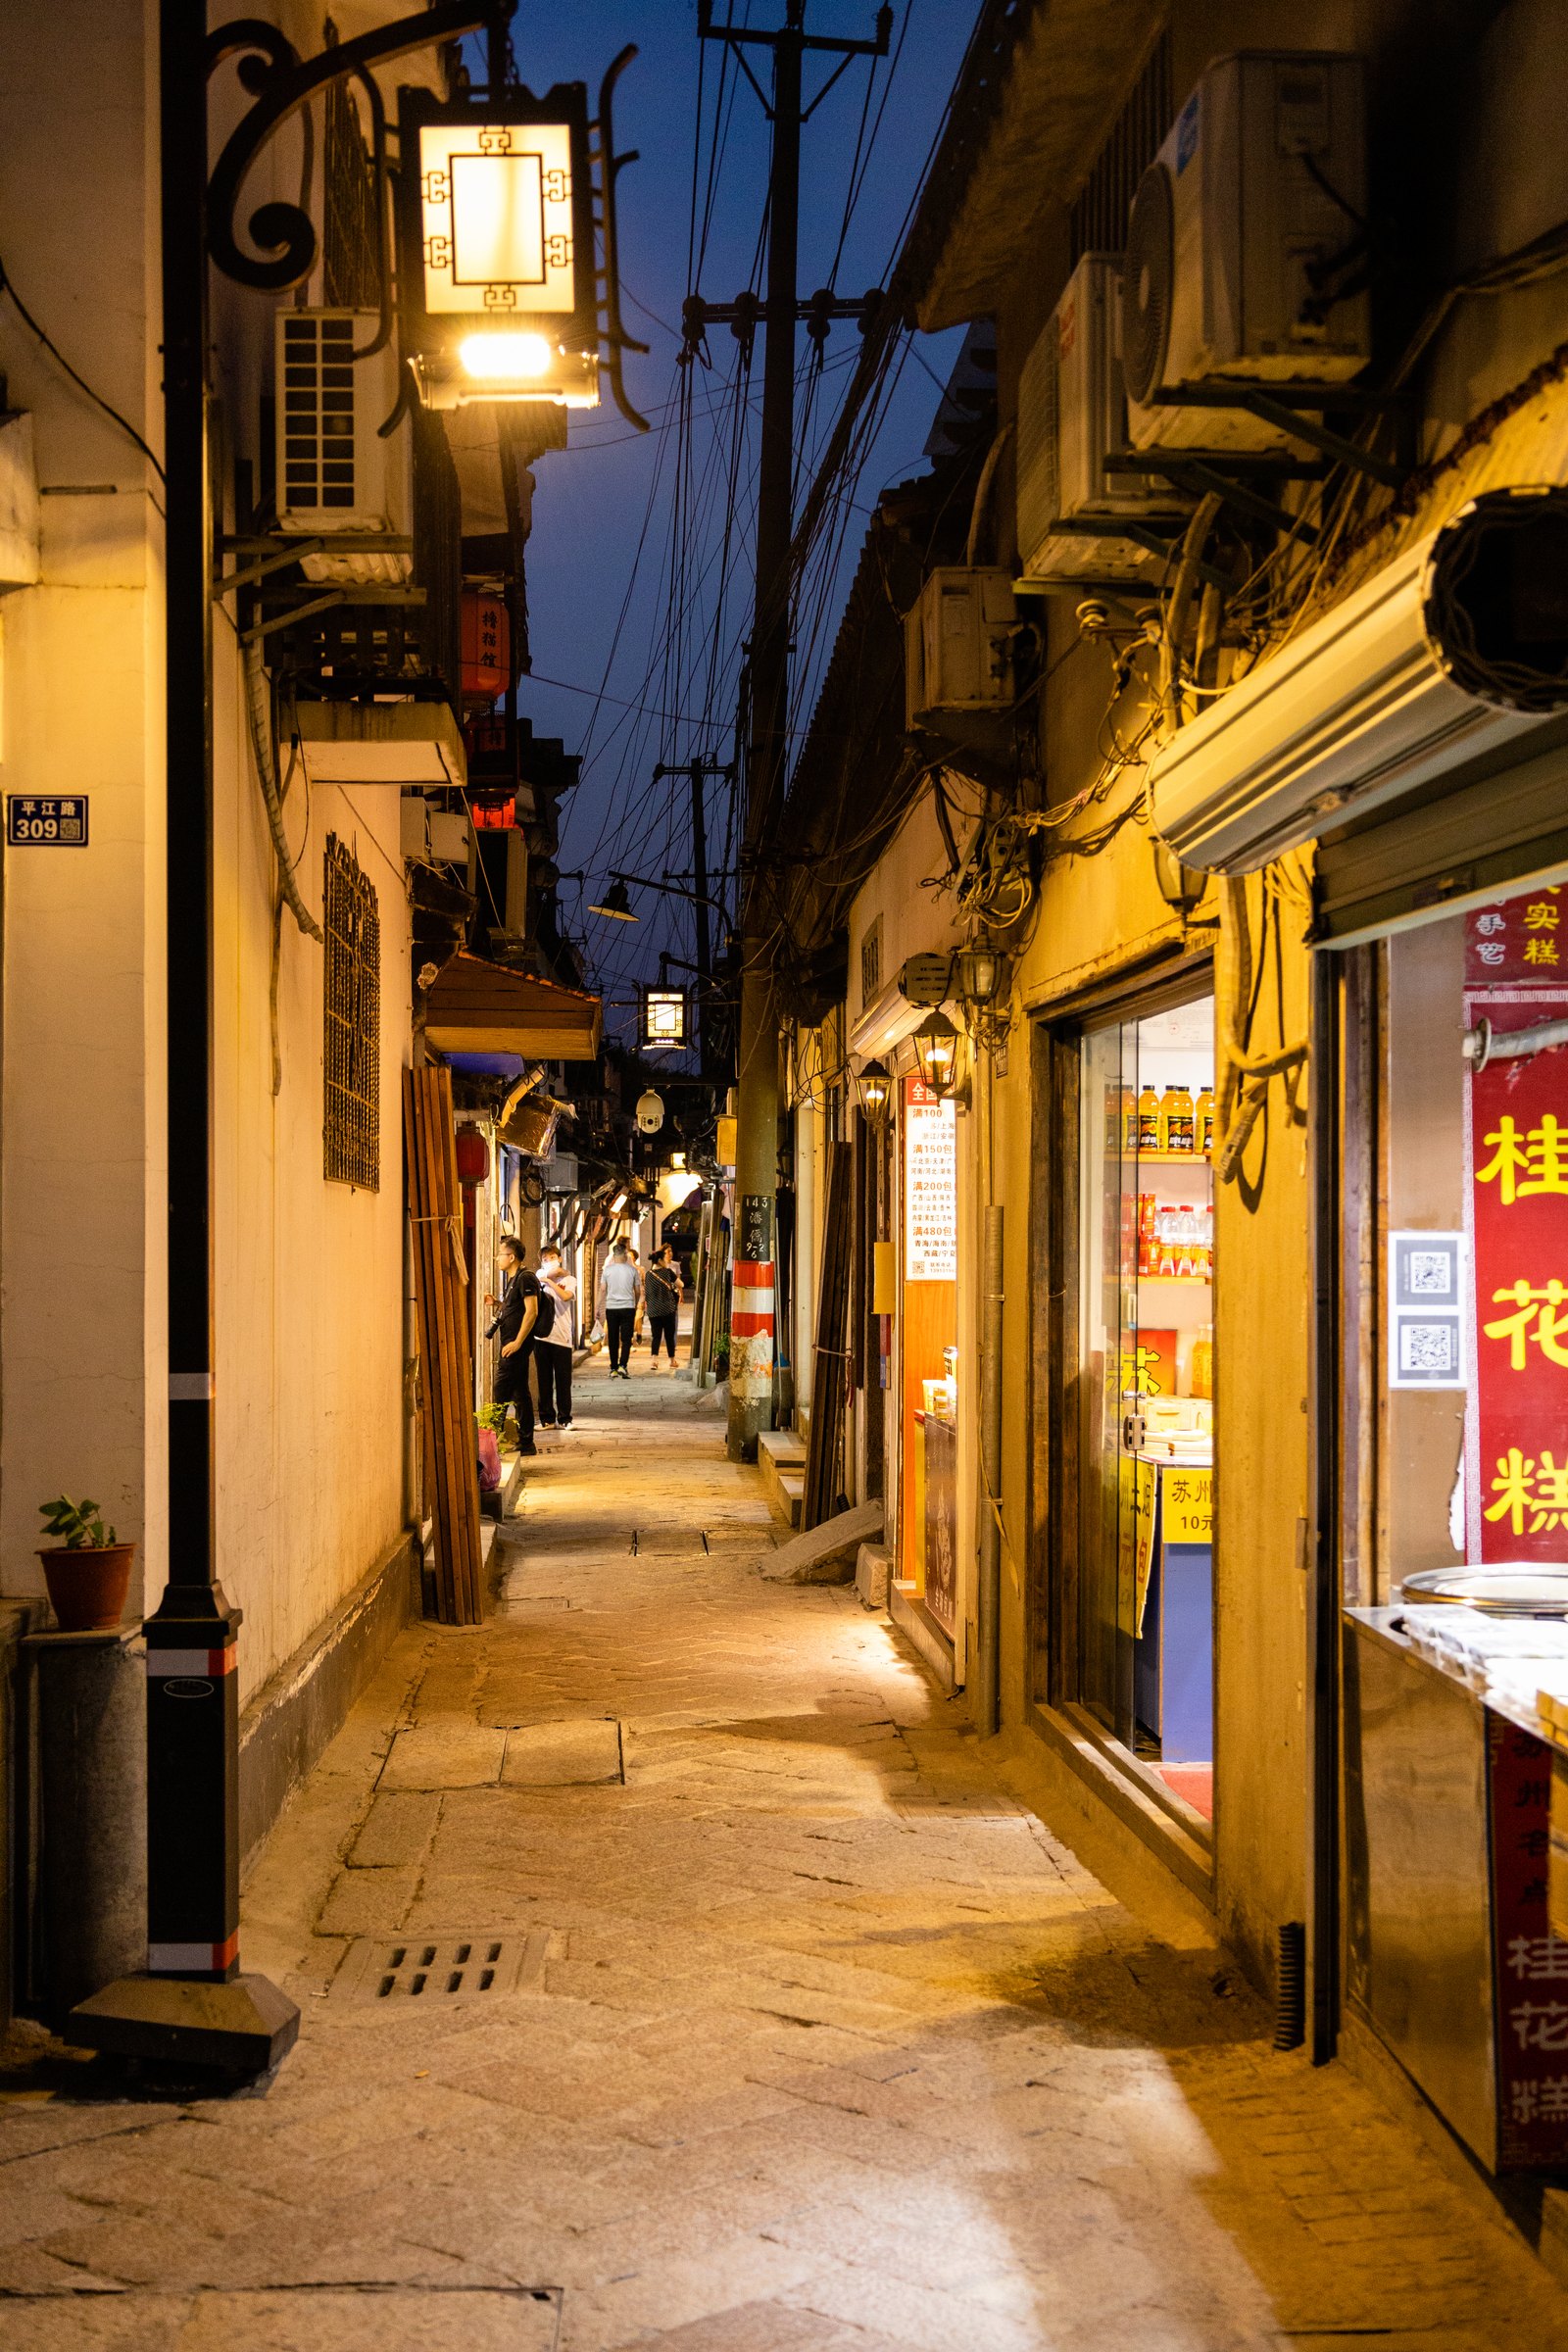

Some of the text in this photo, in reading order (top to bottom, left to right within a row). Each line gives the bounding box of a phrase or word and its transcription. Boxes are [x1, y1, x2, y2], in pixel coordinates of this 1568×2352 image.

[22, 801, 75, 816] 平江路
[16, 818, 58, 839] 309
[746, 1197, 768, 1208] 143
[746, 1242, 764, 1252] 9-2
[751, 1250, 758, 1259] 6
[1475, 1113, 1568, 1537] 桂花糕
[1172, 1479, 1212, 1503] 苏州
[1181, 1515, 1212, 1531] 10元
[1507, 1935, 1568, 2125] 桂花糕
